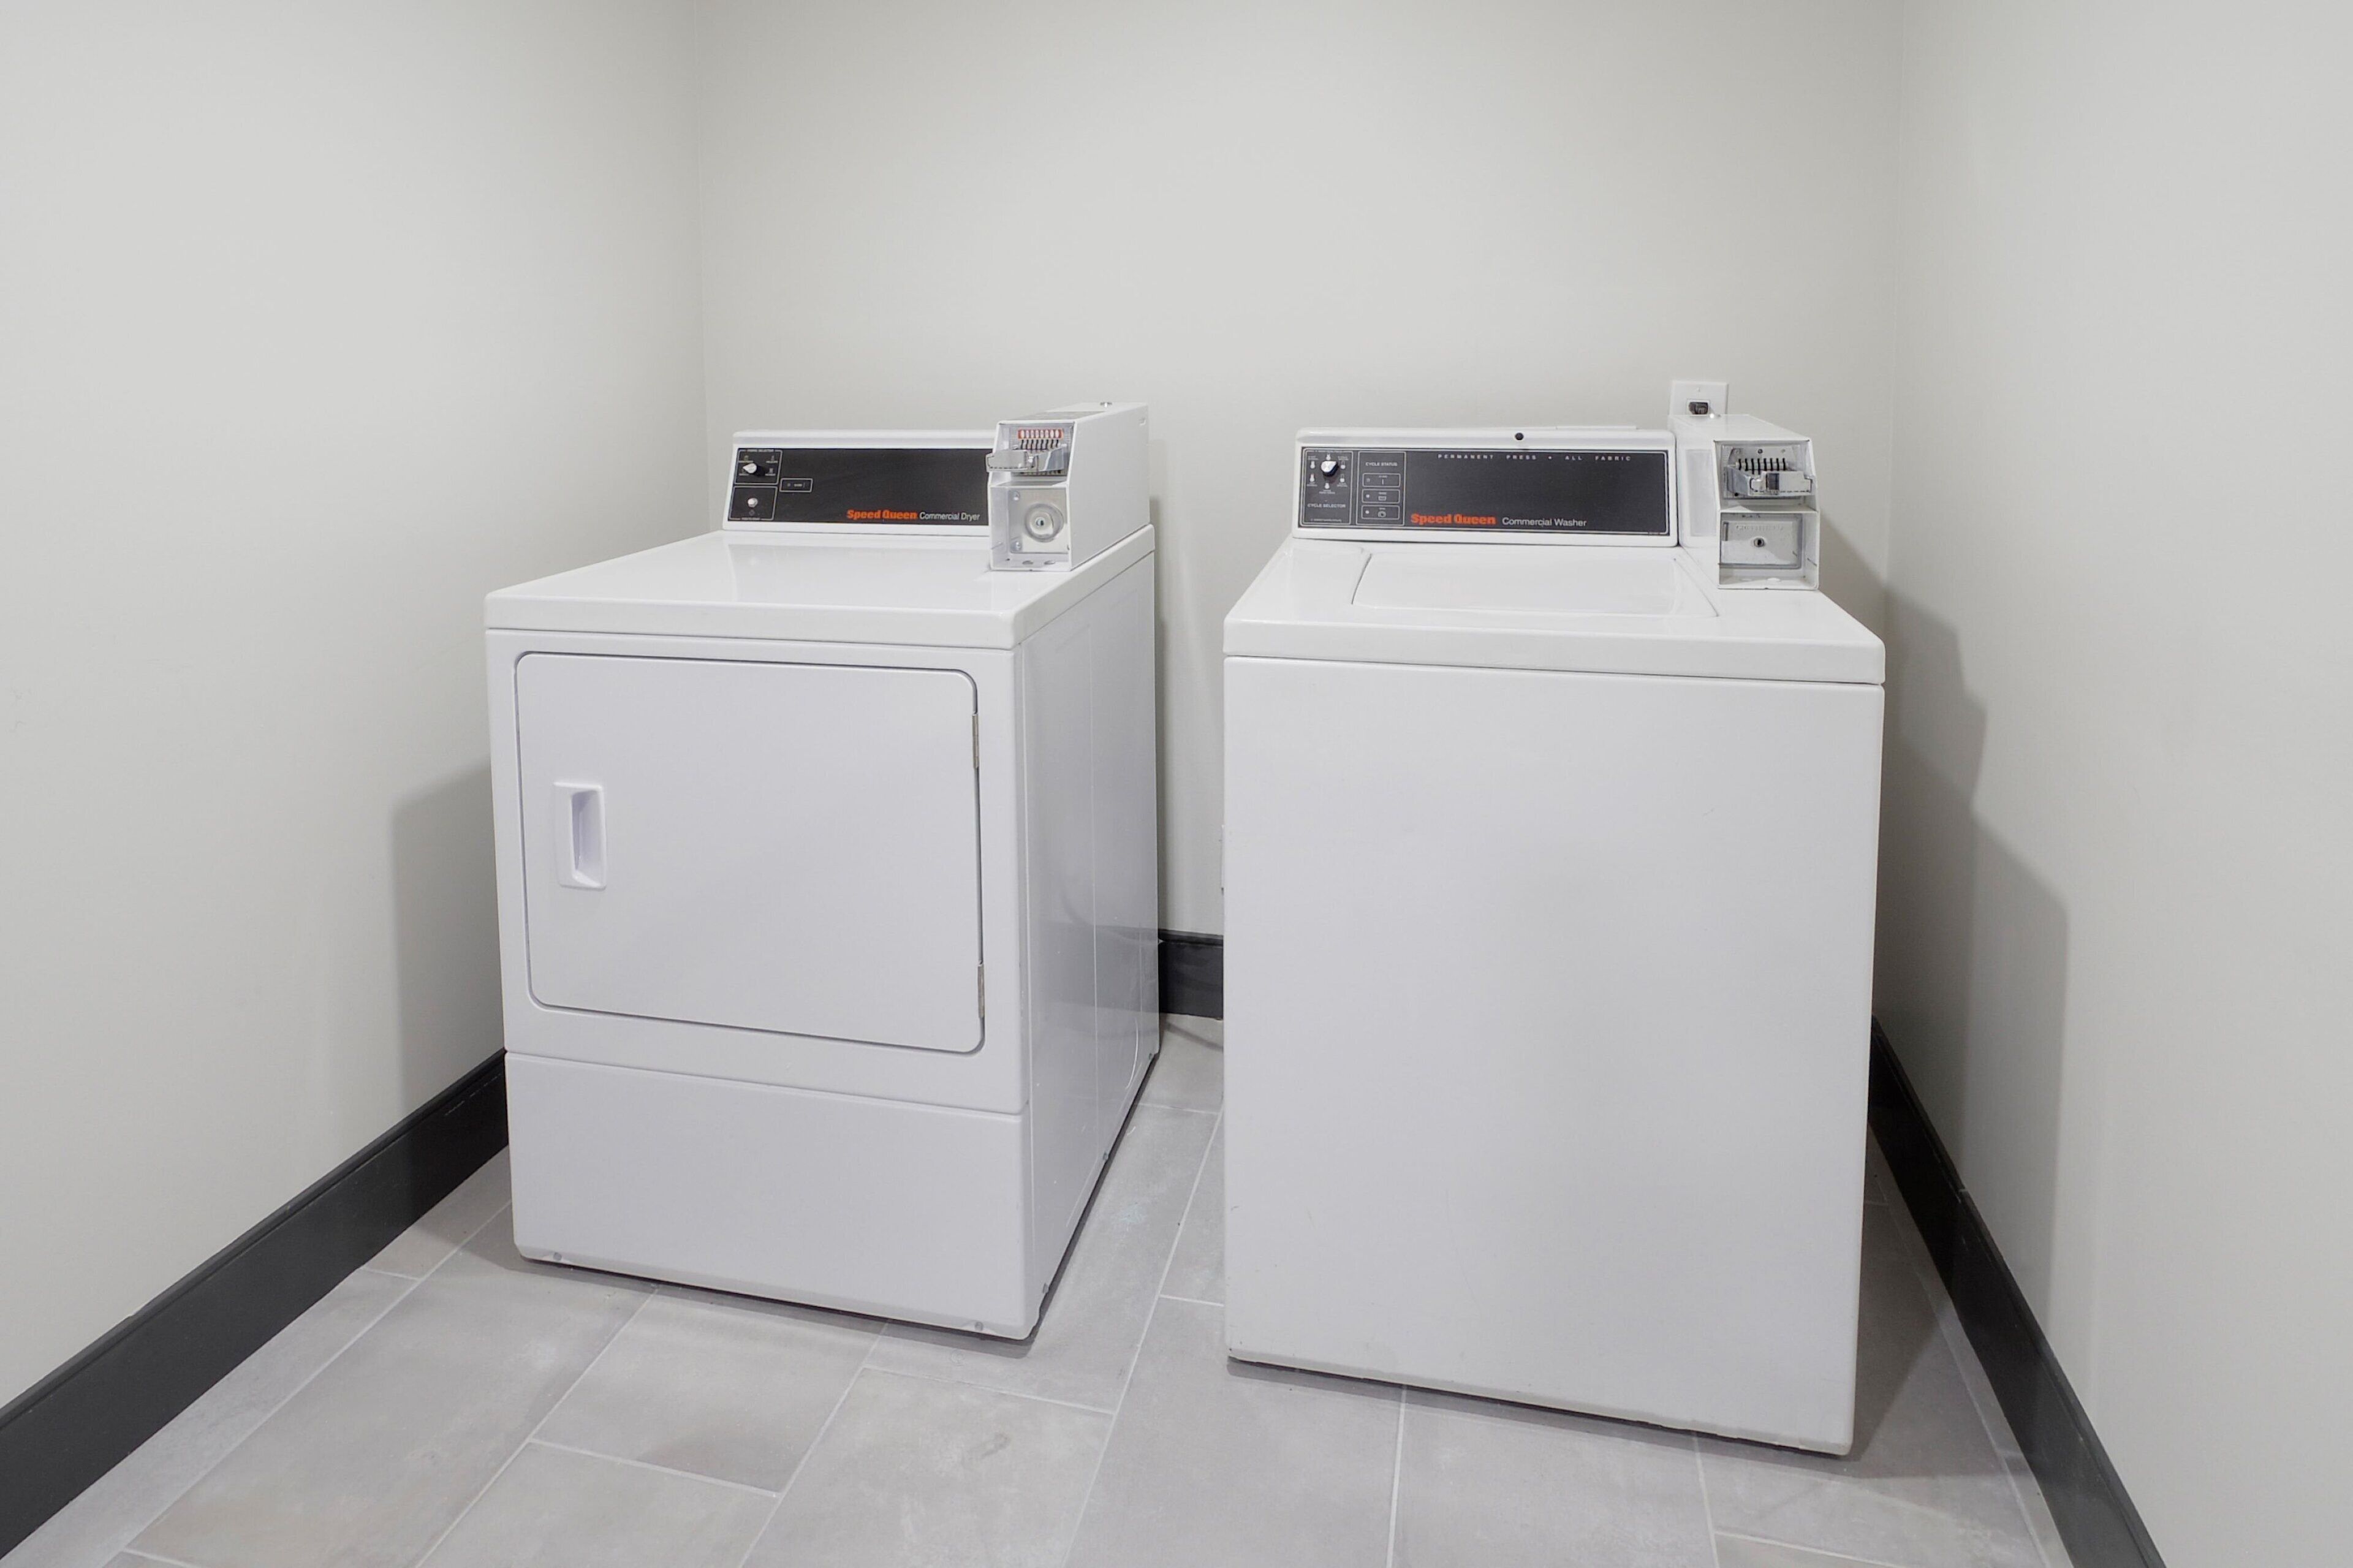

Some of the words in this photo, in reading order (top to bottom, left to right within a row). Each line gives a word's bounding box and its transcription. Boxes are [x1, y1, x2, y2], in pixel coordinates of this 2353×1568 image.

[847, 510, 881, 520] Speed
[882, 510, 917, 520] Queen
[919, 512, 960, 520] Commercial
[961, 512, 980, 522] Dryer
[1411, 513, 1452, 525] Speed
[1453, 513, 1496, 525] Queen
[1502, 517, 1552, 526] Commercial
[1554, 518, 1587, 527] Washer
